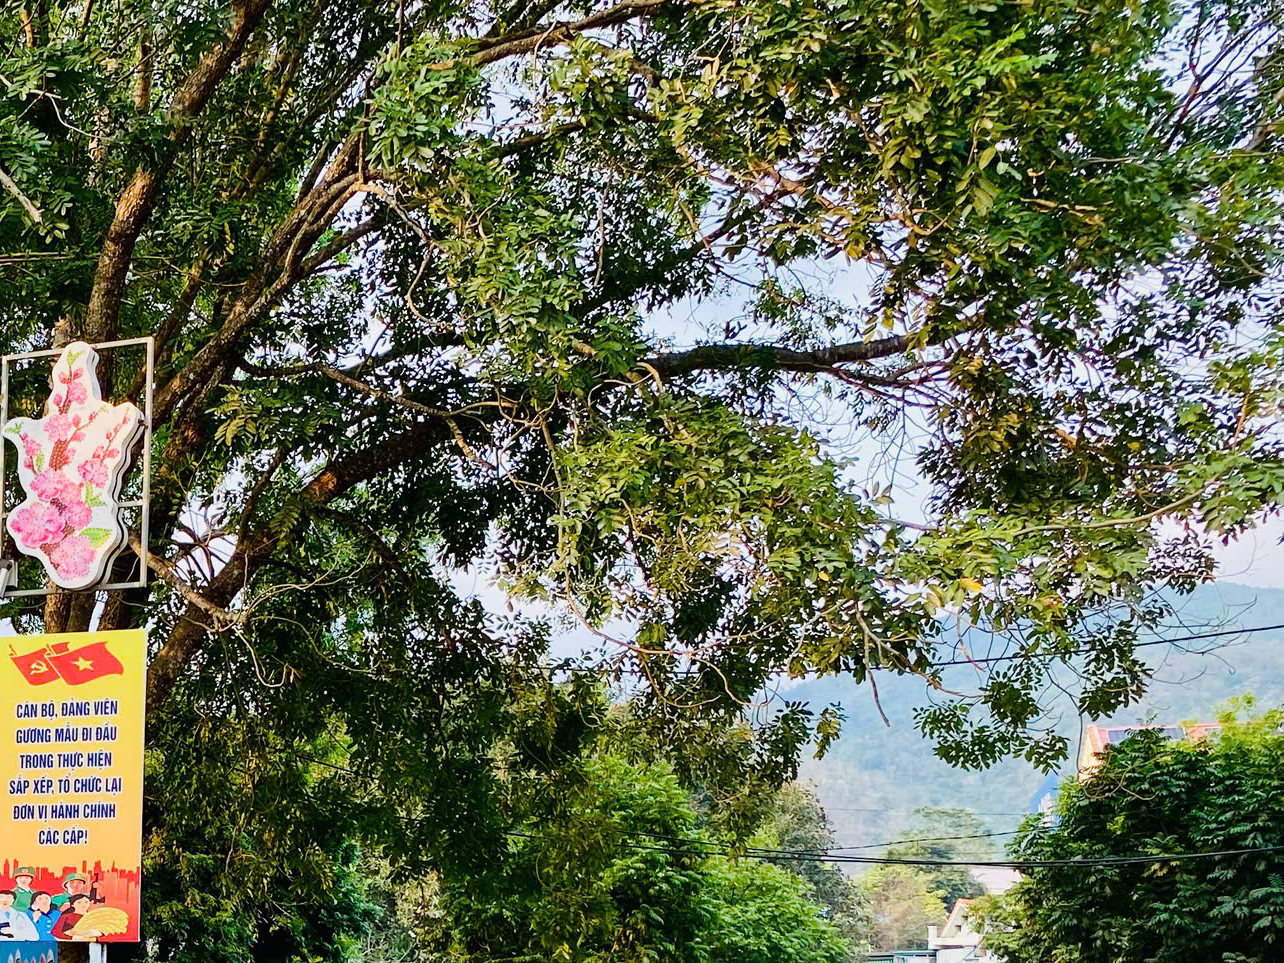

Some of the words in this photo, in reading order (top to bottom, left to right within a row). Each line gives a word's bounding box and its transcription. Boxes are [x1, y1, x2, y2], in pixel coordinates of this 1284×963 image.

[16, 701, 37, 718] CÁN
[41, 700, 58, 720] BỘ,
[61, 697, 90, 716] ĐẢNG
[94, 698, 118, 715] VIÊN
[16, 728, 51, 743] GƯƠNG
[55, 722, 78, 742] MẪU
[82, 728, 92, 741] ĐI
[20, 754, 53, 768] TRONG
[57, 752, 83, 770] THỰC
[87, 749, 112, 770] HIỆN
[9, 775, 29, 794] SẮP
[33, 775, 54, 794] XẾP,
[74, 776, 101, 792] CHỨC
[105, 778, 121, 796] LẠI
[13, 804, 34, 819] ĐƠN
[38, 805, 47, 822] VỊ
[51, 802, 79, 819] HÀNH
[83, 801, 116, 818] CHÍNH
[39, 827, 59, 844] CÁC
[63, 825, 88, 844] CẤP!
